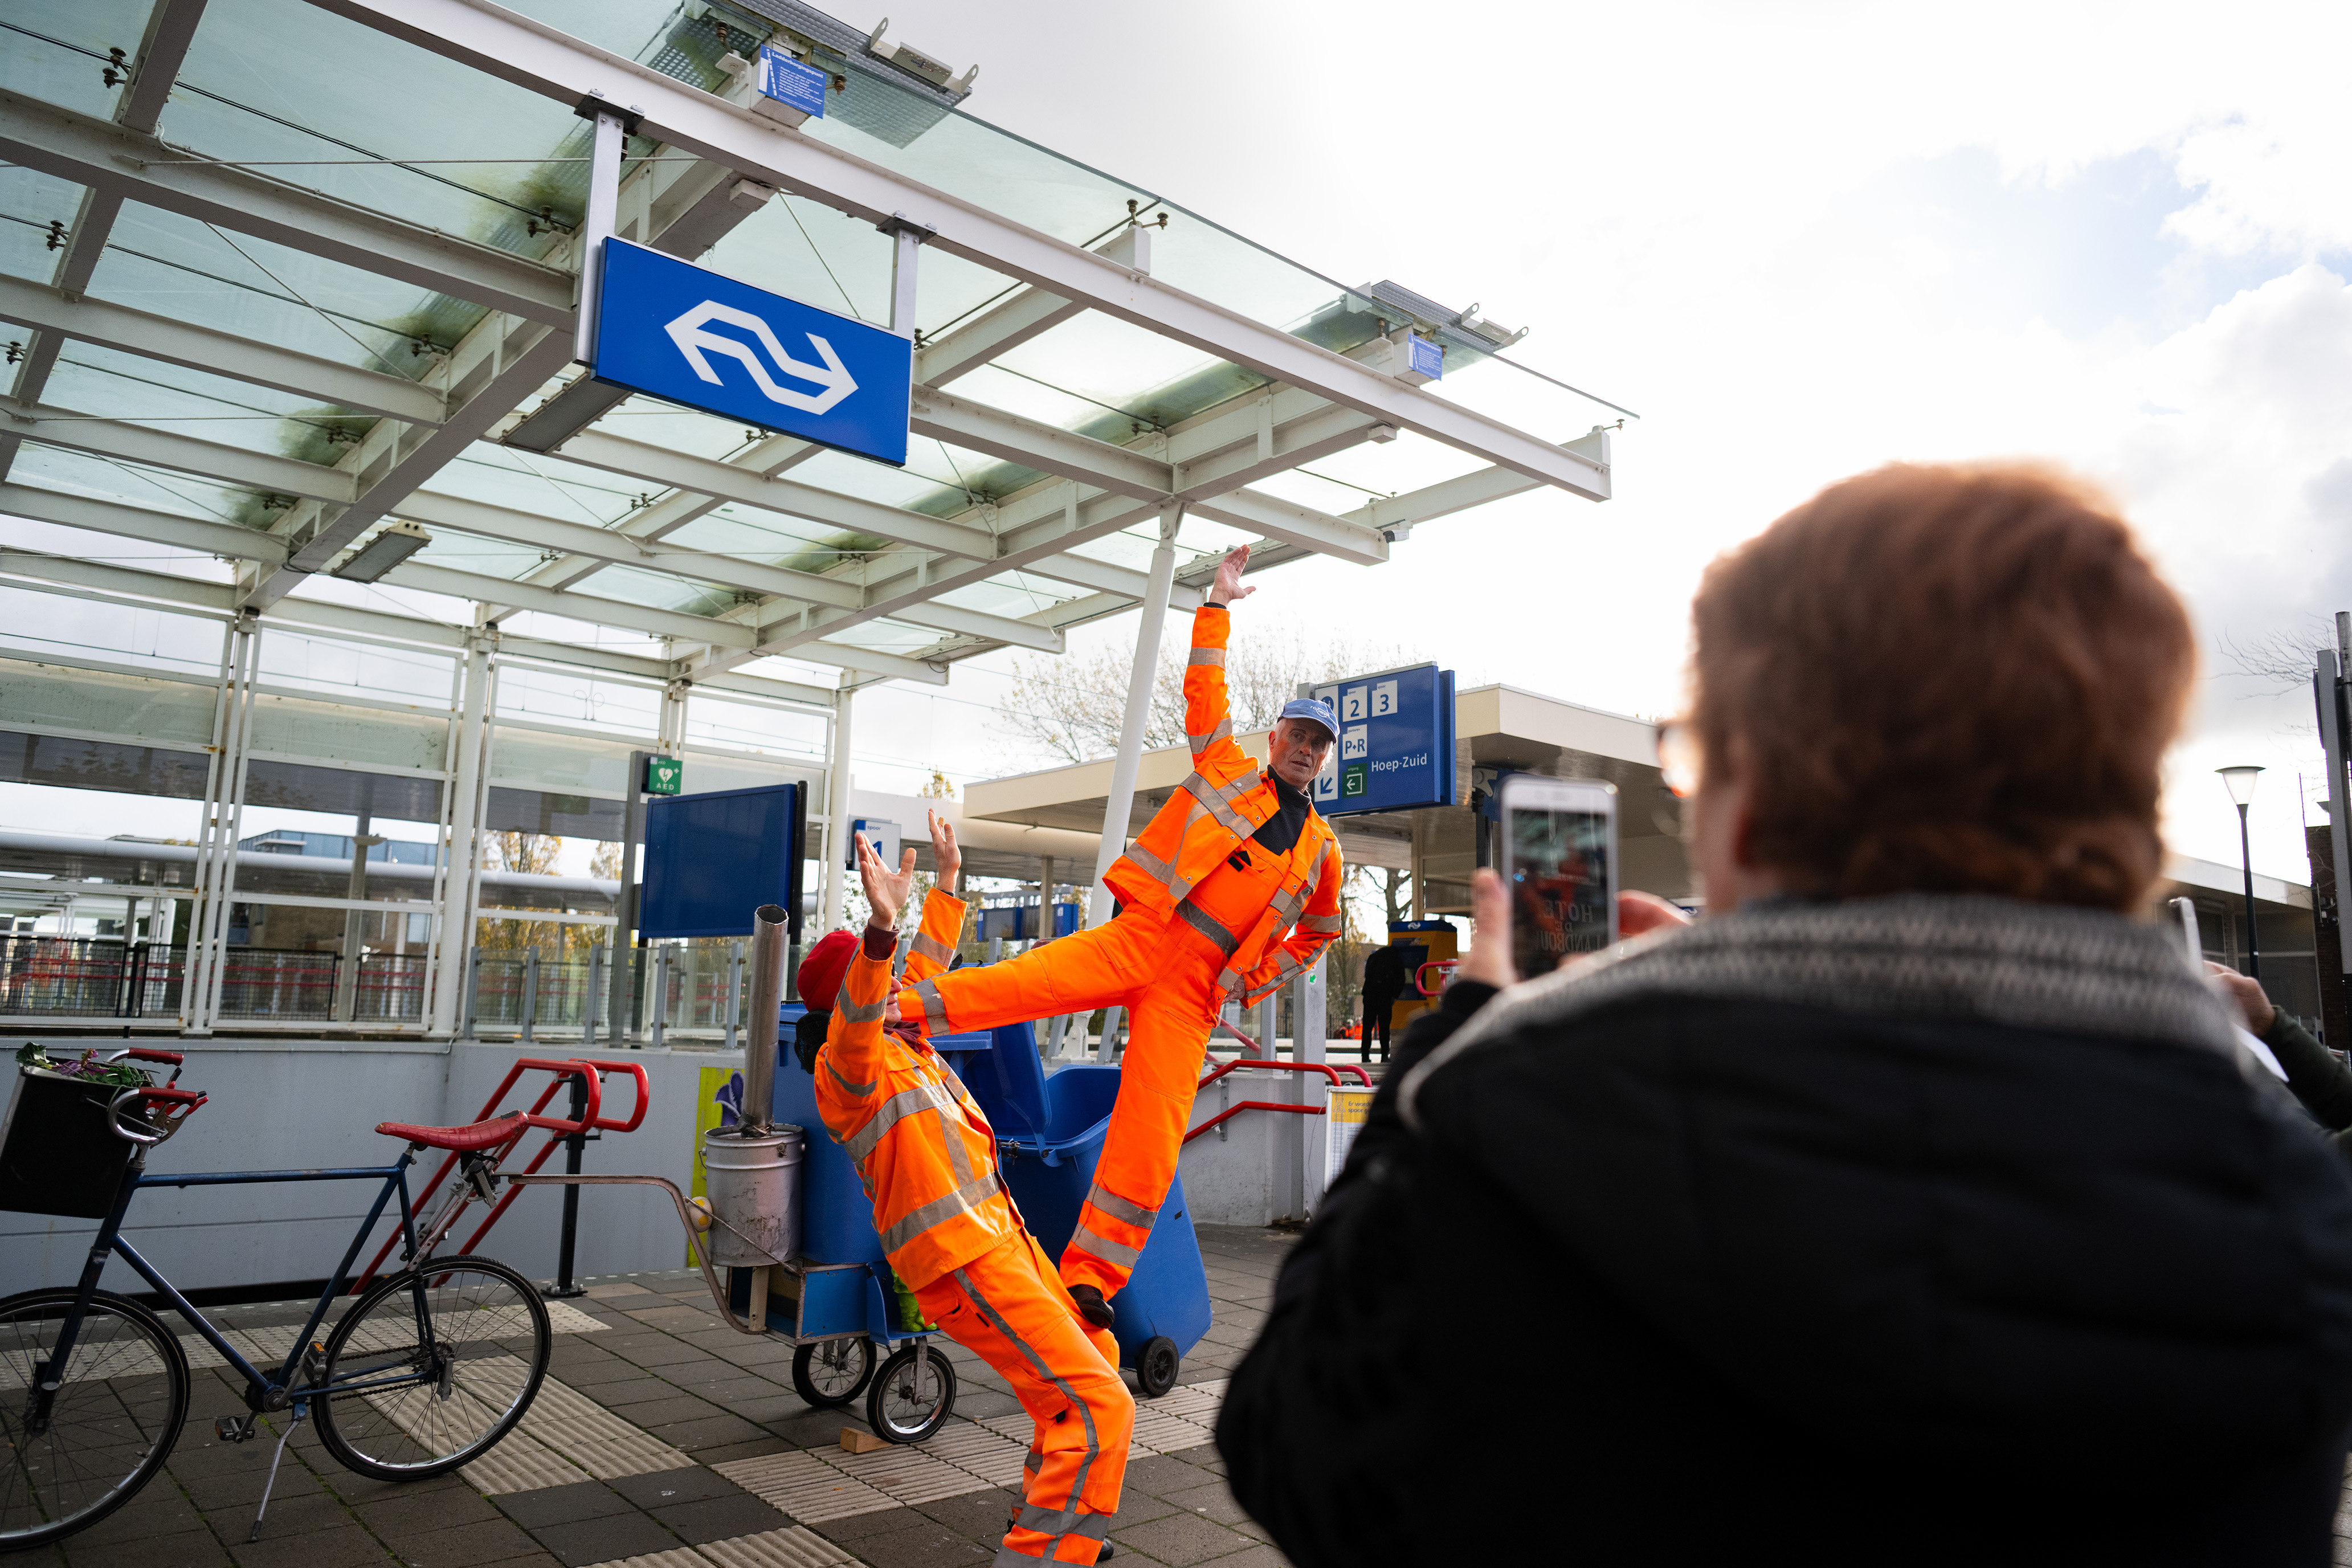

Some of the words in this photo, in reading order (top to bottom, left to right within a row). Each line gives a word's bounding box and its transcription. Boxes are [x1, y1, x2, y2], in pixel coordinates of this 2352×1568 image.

[772, 52, 823, 79] Ladderborgingspunt
[1350, 699, 1359, 718] 2
[1380, 693, 1389, 712] 3
[1371, 753, 1427, 772] Hoep-Zuid
